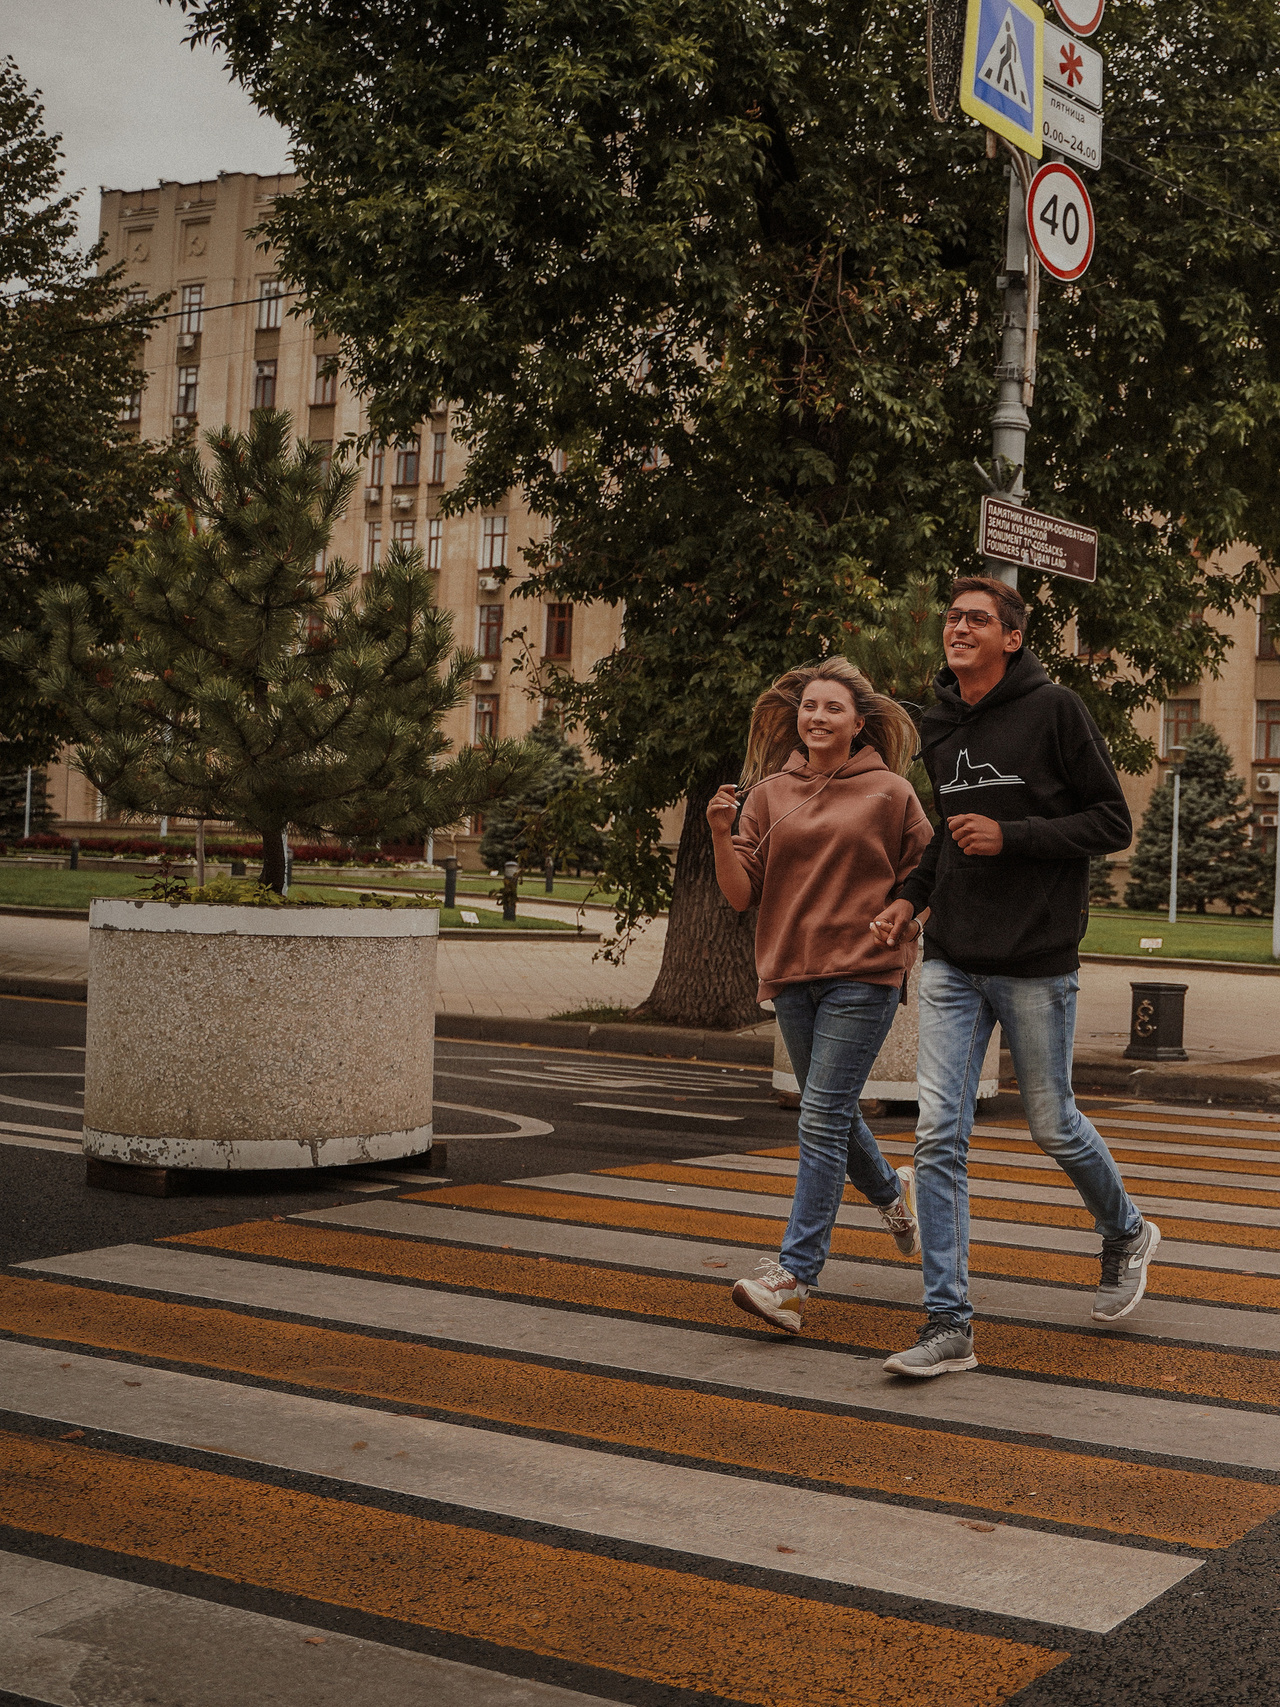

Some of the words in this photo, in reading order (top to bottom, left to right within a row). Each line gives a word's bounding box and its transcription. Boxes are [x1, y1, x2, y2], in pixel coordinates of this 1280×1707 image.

[1050, 98, 1085, 123] пятница
[1040, 194, 1079, 245] 40
[987, 528, 1022, 545] MONUMENT
[988, 505, 1023, 523] ПАМЯТНИК
[1024, 516, 1095, 544] КАЗАКАМ-ОСНОВАТЕЛЯМ
[988, 516, 1011, 532] ЗЕМЛИ
[1011, 522, 1048, 542] КУБАНСКОЙ
[986, 539, 1020, 557] FOUNDERS
[1051, 556, 1067, 569] LAND
